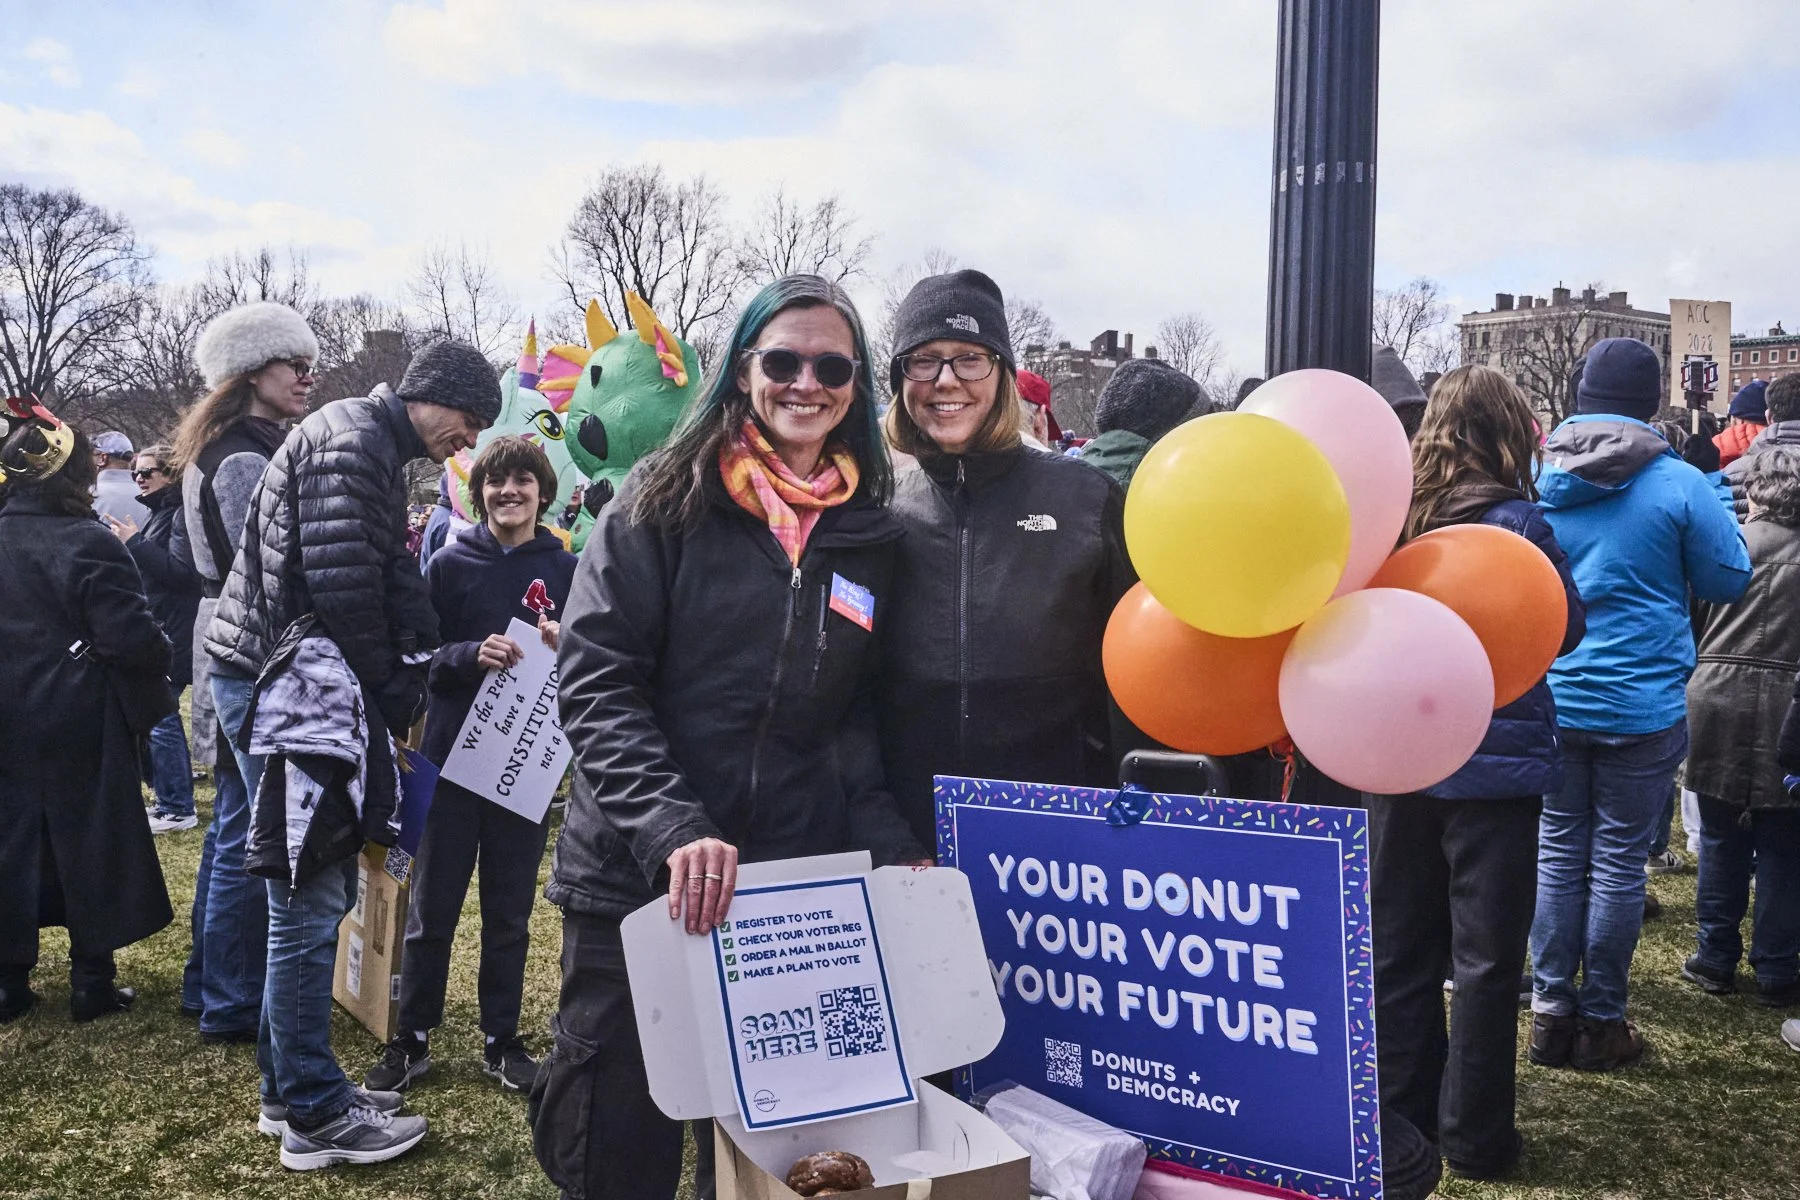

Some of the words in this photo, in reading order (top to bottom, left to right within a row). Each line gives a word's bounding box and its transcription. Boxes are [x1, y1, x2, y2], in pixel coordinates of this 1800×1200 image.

[1687, 304, 1709, 324] AOC
[1688, 333, 1712, 353] 2028
[1016, 519, 1043, 527] NORTH
[462, 724, 482, 752] We
[474, 700, 494, 724] the
[487, 667, 517, 699] Peop
[494, 705, 520, 736] have
[515, 693, 525, 704] a
[496, 663, 559, 797] CONSTITUTIO
[540, 747, 556, 769] not
[551, 735, 562, 747] a
[988, 852, 1110, 906] YOUR
[1122, 868, 1300, 930] DONUT
[735, 916, 786, 930] REGISTER
[787, 913, 802, 923] TO
[804, 910, 834, 921] VOTE
[738, 931, 774, 946] CHECK
[775, 929, 804, 941] YOUR
[805, 925, 841, 938] VOTER
[842, 922, 862, 933] REG
[741, 950, 777, 963] ORDER
[779, 948, 788, 957] A
[789, 945, 814, 957] MAIL
[815, 943, 827, 953] IN
[828, 937, 868, 951] BALLOT
[1006, 908, 1128, 965] YOUR
[1140, 928, 1284, 989] VOTE
[743, 965, 775, 980] MAKE
[776, 963, 785, 974] A
[786, 961, 814, 973] PLAN
[815, 959, 830, 969] TO
[831, 954, 861, 967] VOTE
[740, 1006, 814, 1039] SCAN
[987, 958, 1105, 1016] YOUR
[1118, 980, 1318, 1055] FUTURE
[744, 1030, 818, 1063] HERE
[1091, 1049, 1177, 1082] DONUTS
[1106, 1073, 1240, 1116] DEMOCRACY
